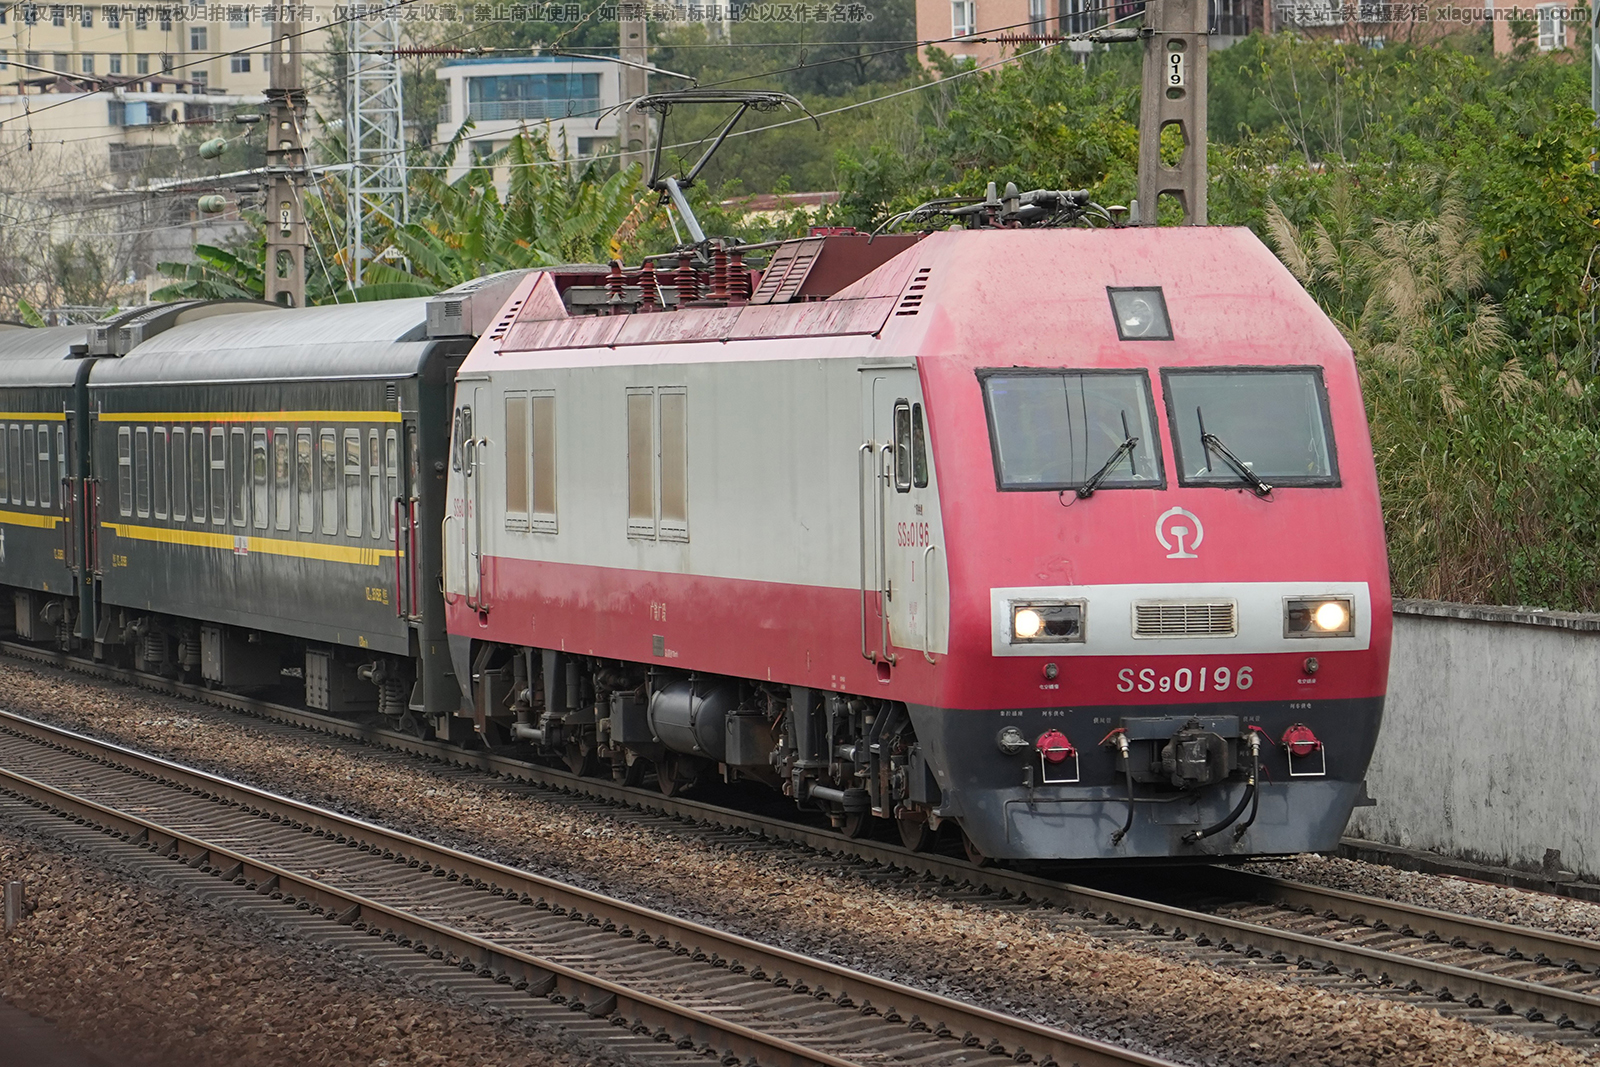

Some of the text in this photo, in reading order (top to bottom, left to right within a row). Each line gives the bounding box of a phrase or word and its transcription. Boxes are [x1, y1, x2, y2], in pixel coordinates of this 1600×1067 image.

[1170, 54, 1181, 84] 019
[898, 522, 929, 547] SS90196
[1116, 666, 1254, 693] SS90196
